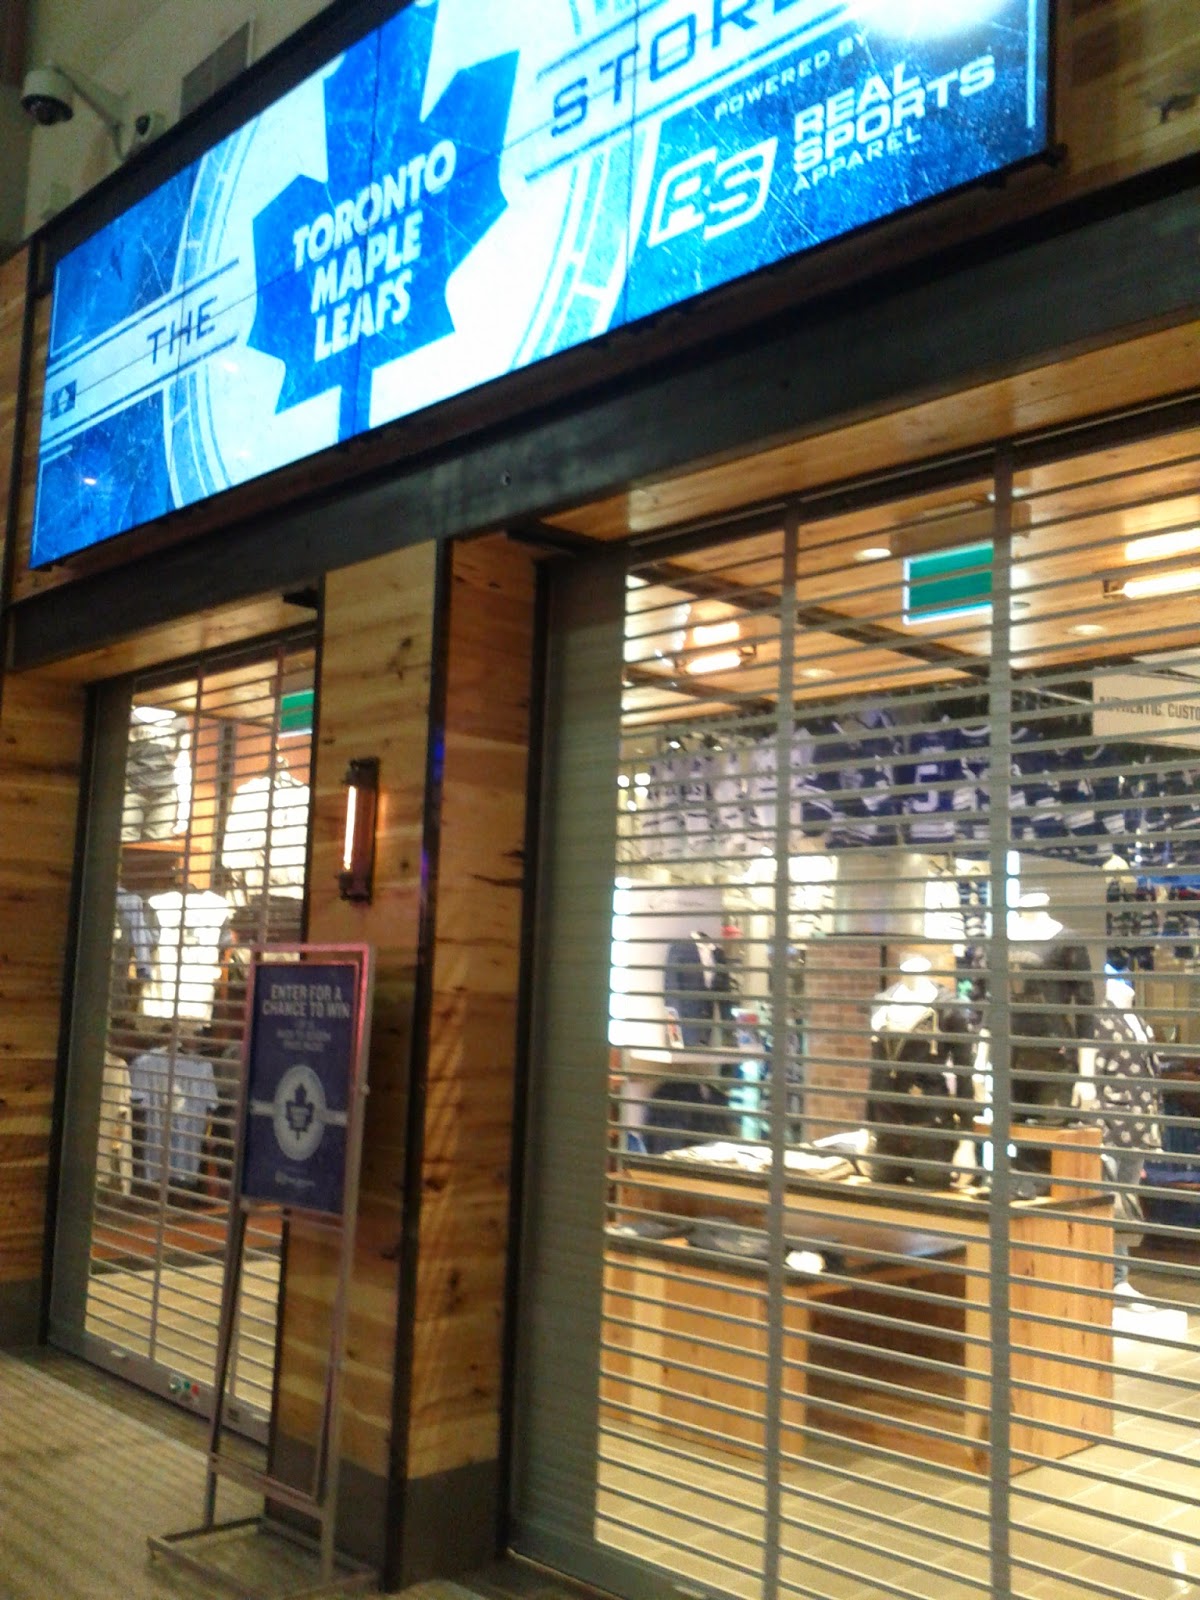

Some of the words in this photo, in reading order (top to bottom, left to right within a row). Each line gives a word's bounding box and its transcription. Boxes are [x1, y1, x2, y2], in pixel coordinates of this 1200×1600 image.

[551, 0, 800, 137] STOR
[714, 50, 831, 121] POWERED
[794, 61, 921, 143] REAL
[793, 54, 996, 174] SPORTS
[793, 126, 922, 196] APPAREL
[293, 139, 457, 272] TORONTO
[311, 209, 423, 314] MAPLE
[147, 296, 218, 365] THE
[315, 268, 412, 363] LEAFS
[263, 1000, 305, 1017] CHANCE
[310, 1001, 324, 1018] TO
[327, 1003, 350, 1019] WIN
[271, 984, 306, 1001] ENTER
[309, 985, 331, 1001] FOR
[334, 986, 342, 1001] A
